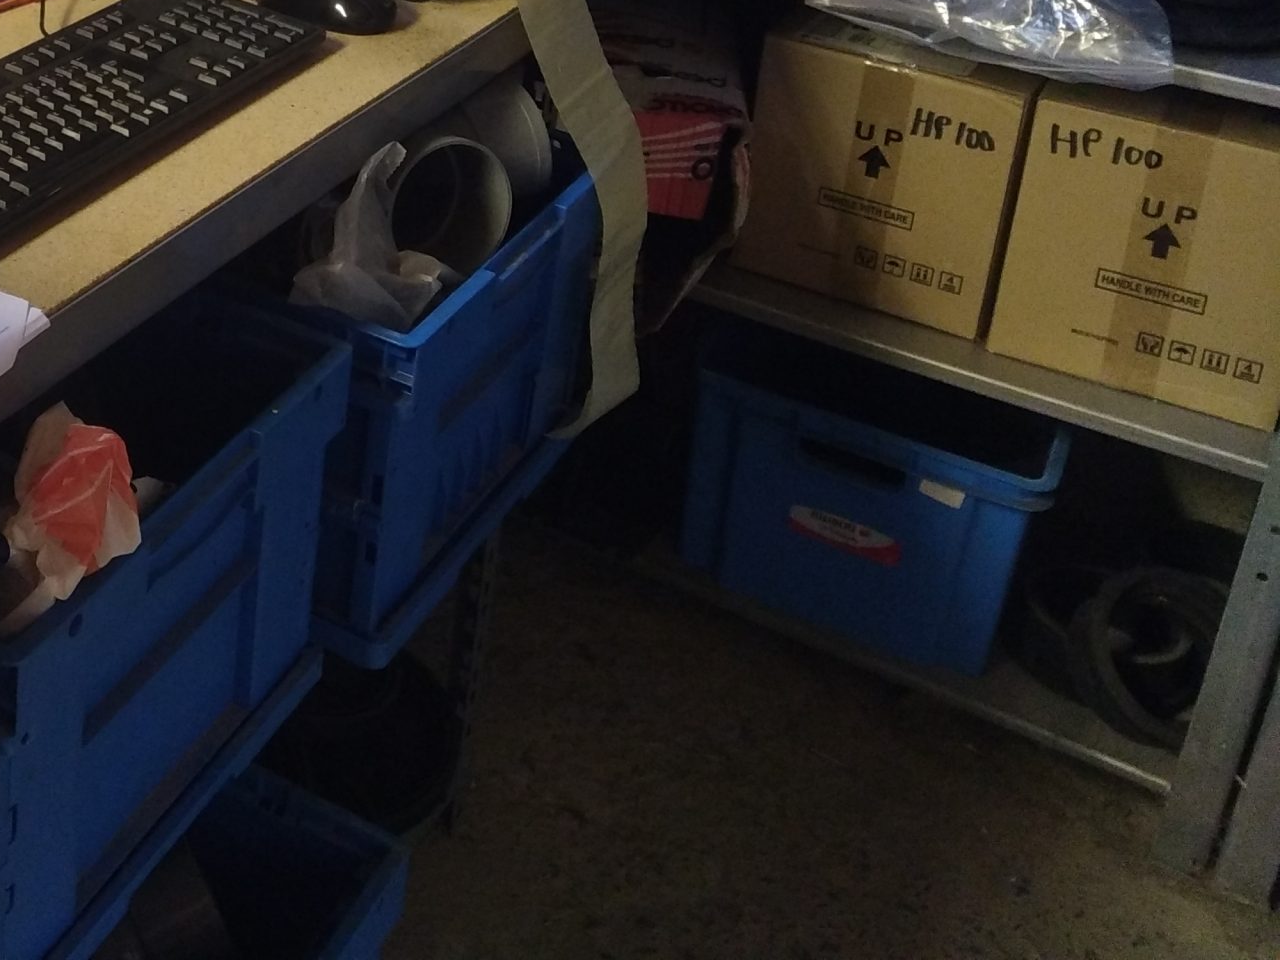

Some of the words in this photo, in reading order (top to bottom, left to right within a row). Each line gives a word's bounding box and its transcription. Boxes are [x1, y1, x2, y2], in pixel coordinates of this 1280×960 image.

[854, 119, 904, 147] UP
[909, 107, 953, 140] HP
[954, 121, 996, 152] 100
[1050, 122, 1103, 158] HP
[1111, 135, 1164, 170] 100
[884, 209, 908, 225] CARE
[1141, 196, 1198, 225] UP
[1101, 273, 1141, 293] HANDLE
[1144, 285, 1170, 301] WITH
[1172, 292, 1202, 309] CARE
